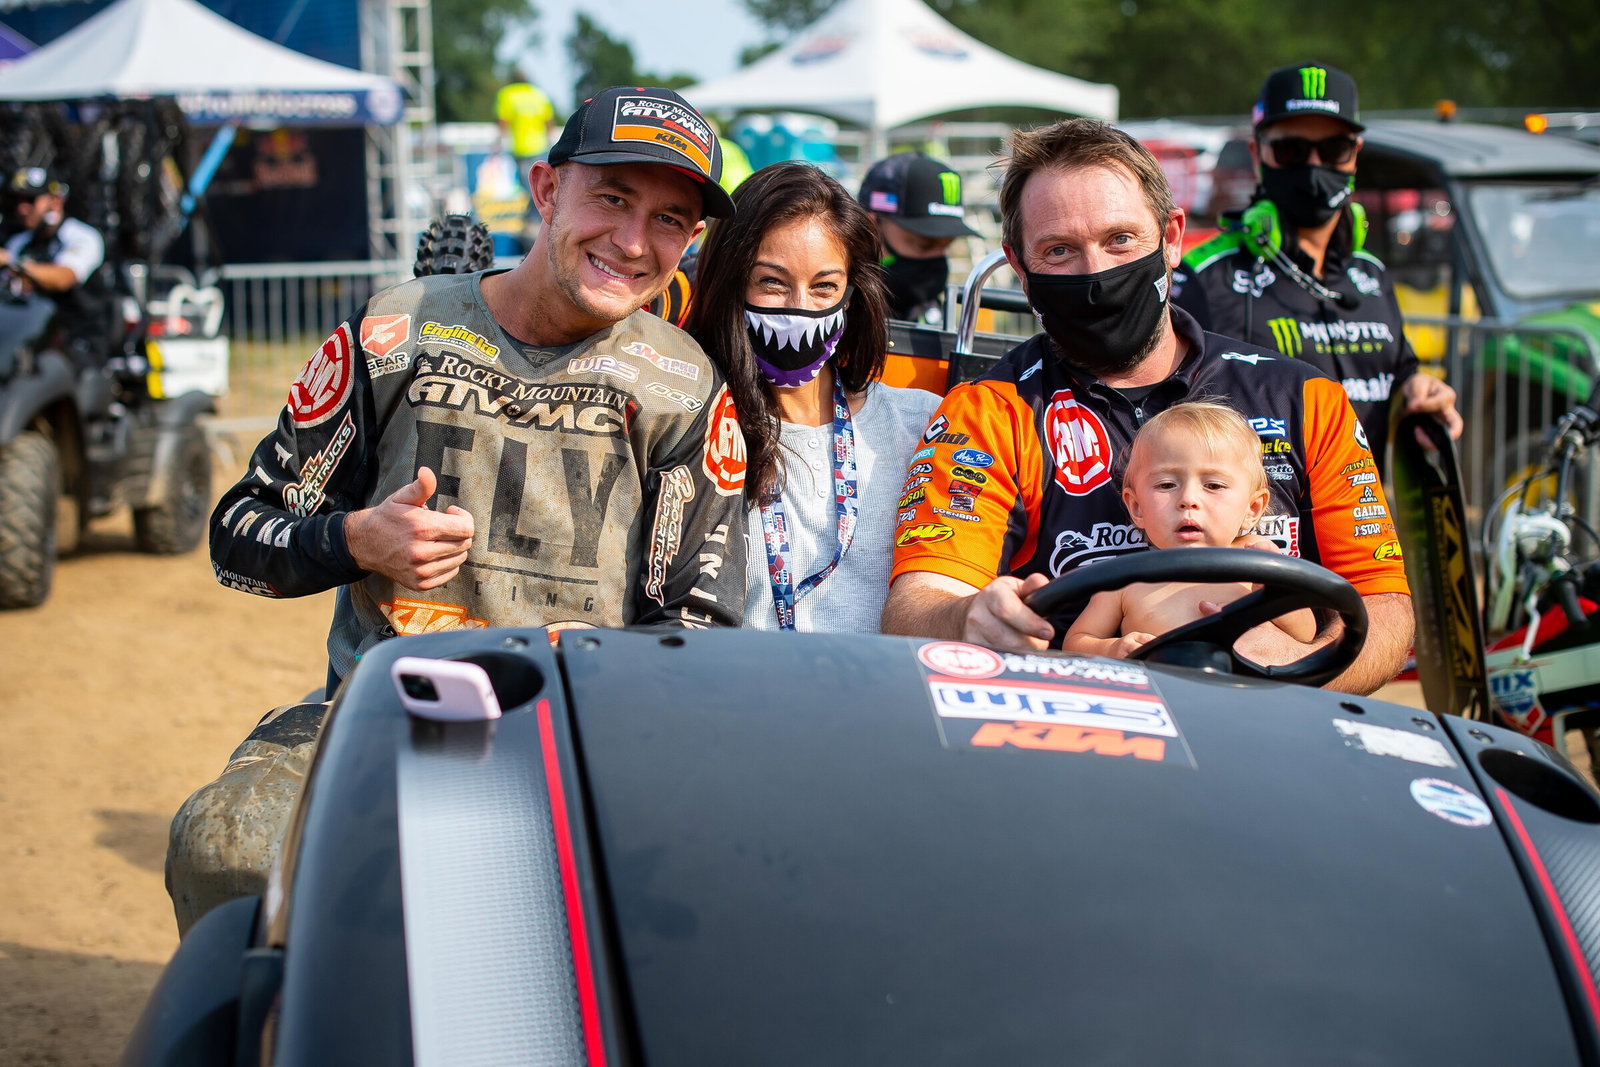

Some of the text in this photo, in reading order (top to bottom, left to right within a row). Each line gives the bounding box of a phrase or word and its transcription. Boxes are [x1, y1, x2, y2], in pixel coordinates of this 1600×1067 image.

[637, 100, 710, 137] ROCKY MOUNTAIN
[654, 132, 688, 151] KTM
[422, 323, 478, 344] Engine
[475, 338, 498, 358] Ice
[1299, 319, 1394, 343] MONSTER
[367, 354, 406, 370] GEAR
[437, 355, 628, 409] ROCKY MOUNTAIN
[413, 420, 629, 568] FLY
[648, 481, 674, 597] SUPERTRUCKS
[219, 569, 268, 589] MOUNTAIN
[937, 687, 1166, 728] WPS
[971, 721, 1166, 761] KTM
